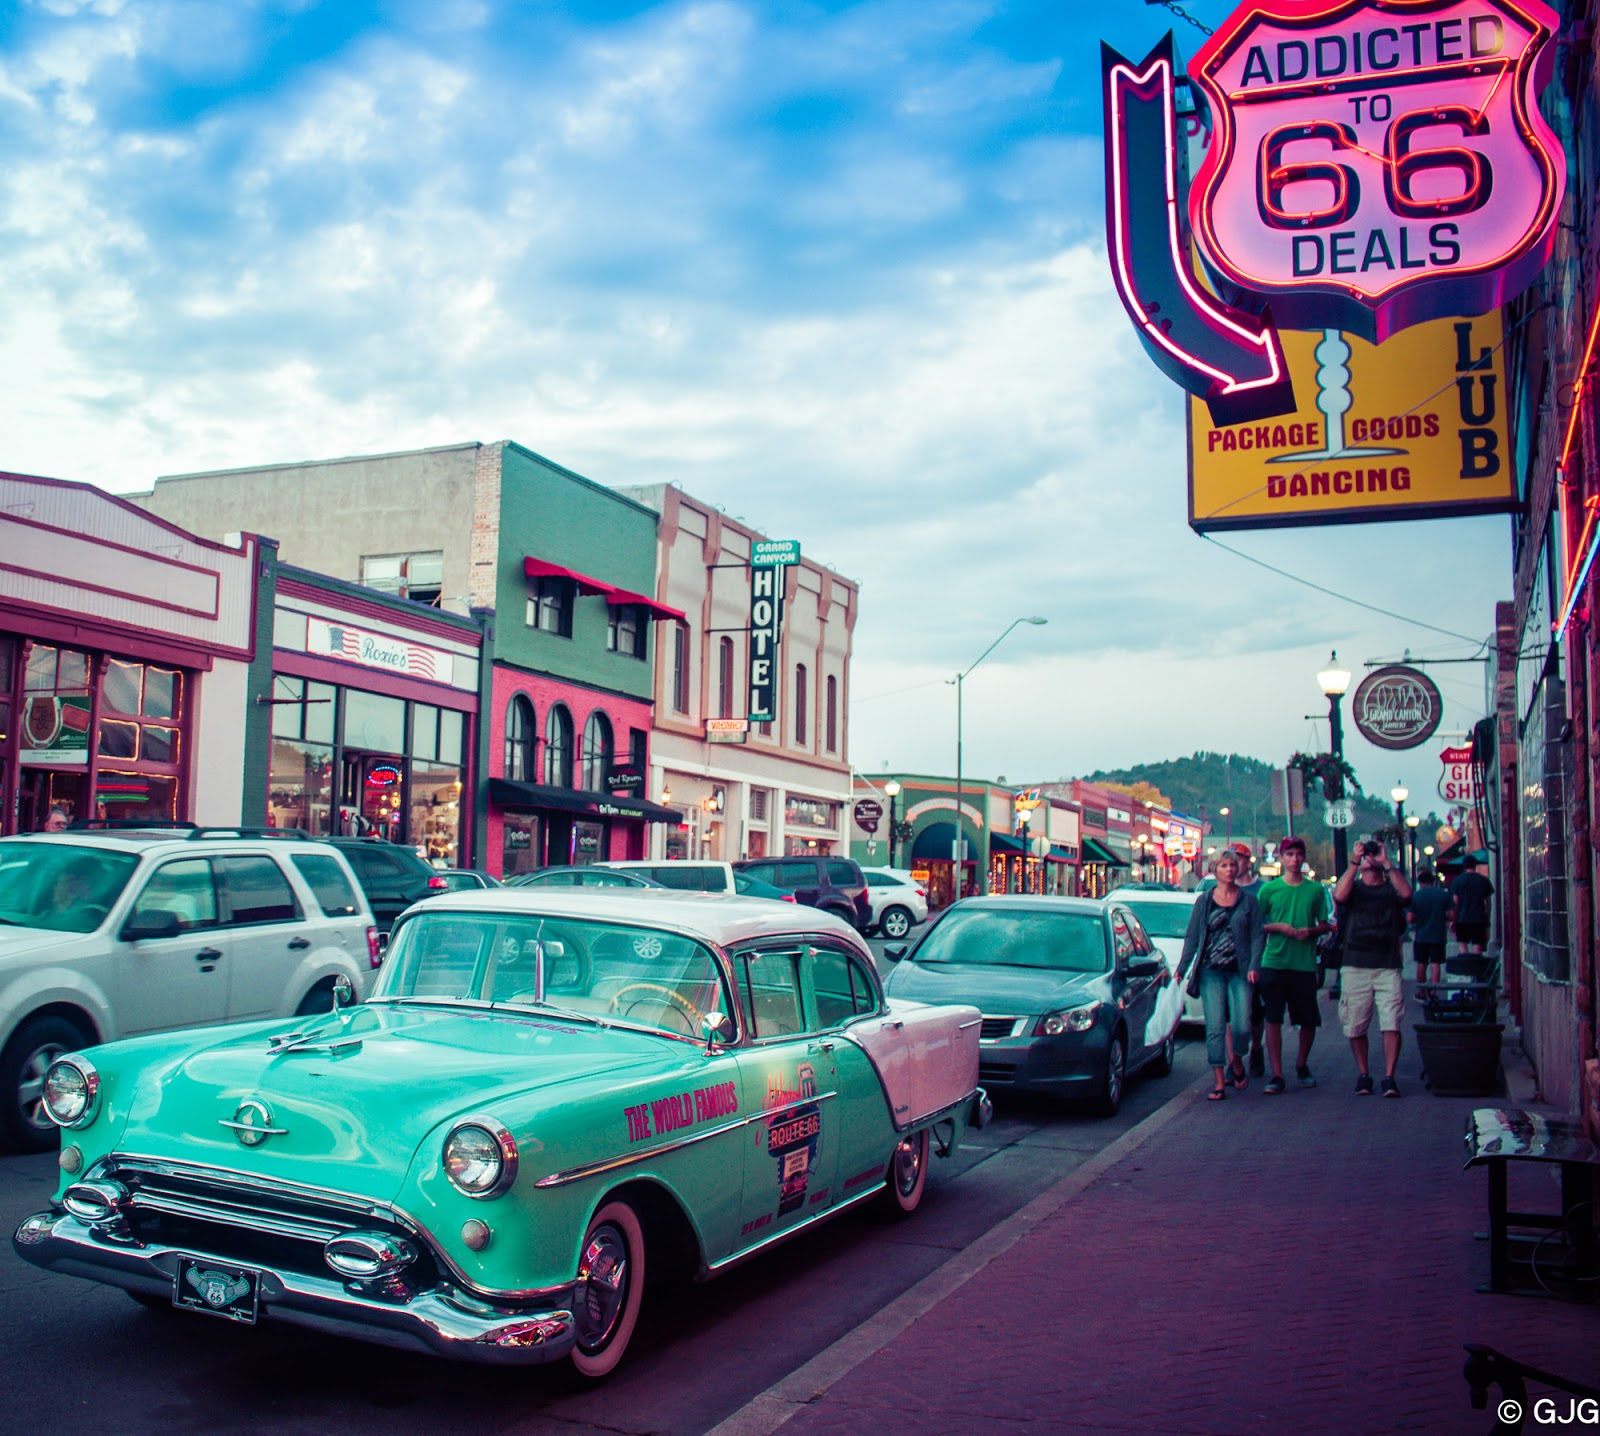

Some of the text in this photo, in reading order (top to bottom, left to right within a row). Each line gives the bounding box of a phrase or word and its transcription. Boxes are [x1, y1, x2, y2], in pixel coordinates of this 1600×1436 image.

[1240, 14, 1503, 87] ADDICTED
[1348, 94, 1391, 124] TO
[1255, 106, 1493, 230] 66
[1292, 223, 1460, 277] DEALS
[1453, 315, 1500, 479] LUB
[1208, 413, 1440, 452] PACKAGE GOODS
[1268, 467, 1411, 498] DANCING
[754, 553, 796, 564] CANYON
[756, 542, 793, 553] GRAND
[362, 637, 407, 668] Roxie's
[752, 571, 773, 715] HOTEL
[711, 721, 745, 730] VACANCY
[1449, 752, 1470, 760] STAT
[1331, 813, 1347, 825] 66
[624, 1081, 738, 1142] THE WORLD FAMOUS
[771, 1115, 818, 1148] ROUTE 66
[210, 1292, 222, 1302] 66
